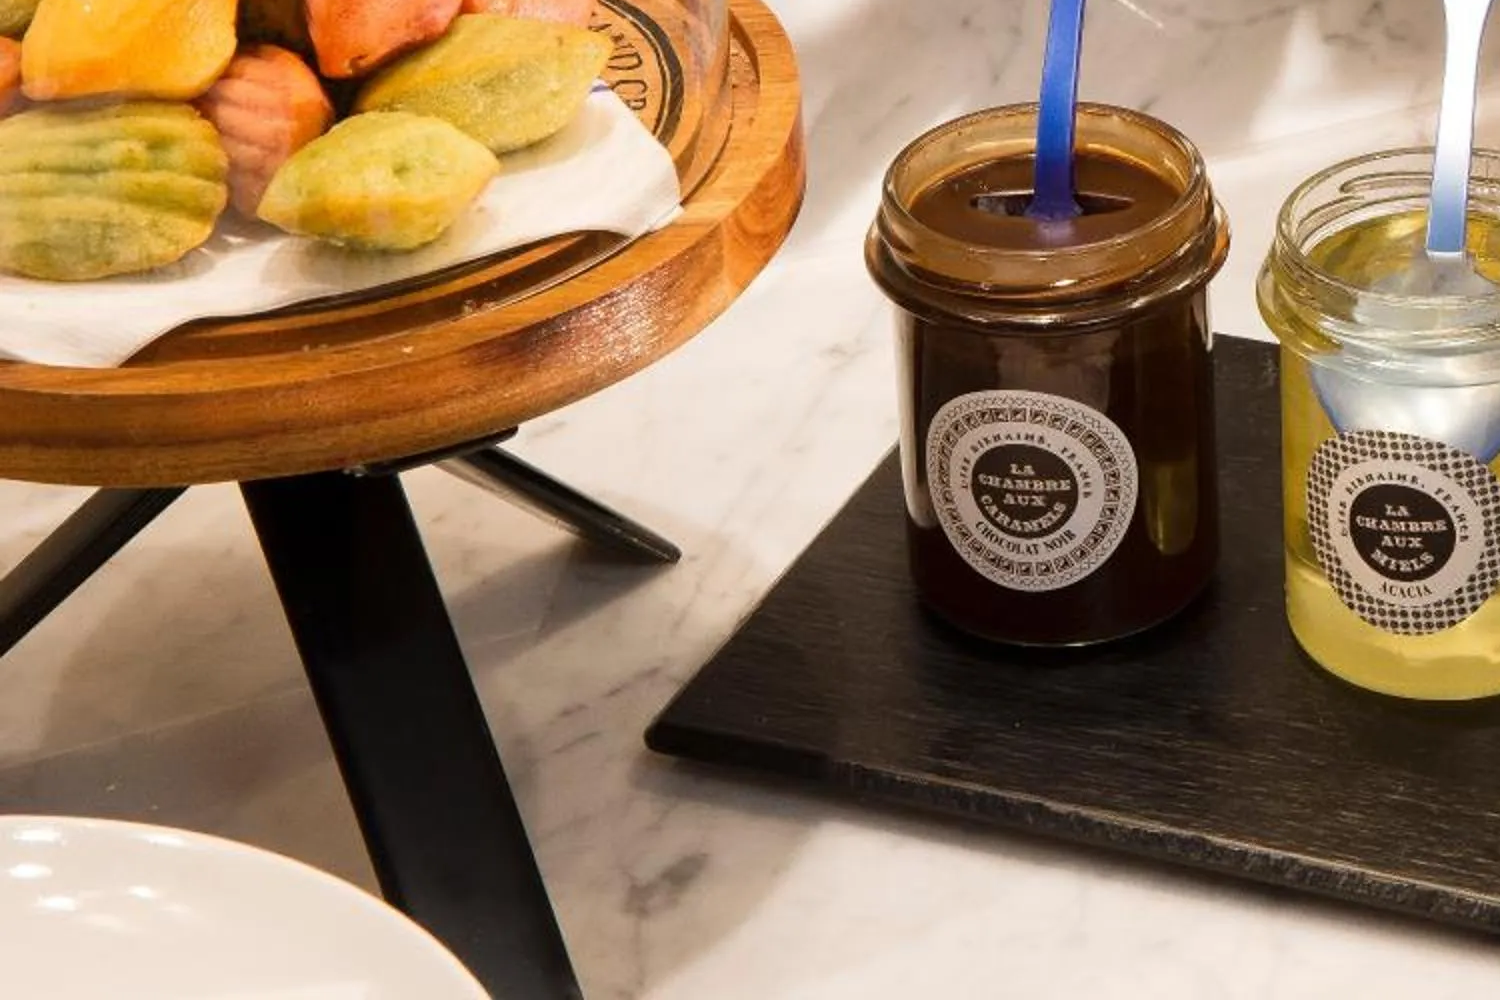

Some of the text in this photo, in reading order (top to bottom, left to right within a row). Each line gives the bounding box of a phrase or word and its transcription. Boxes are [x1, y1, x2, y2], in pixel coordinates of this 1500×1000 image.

[1009, 463, 1035, 475] LA
[977, 473, 1072, 491] CHAMBRE
[1003, 493, 1046, 507] AUX
[981, 495, 1067, 533] CARAMELS
[1384, 504, 1410, 516] LA
[1355, 515, 1449, 532] CHAMBRE
[975, 521, 1077, 554] CHOCOLAT NOIR
[1381, 535, 1424, 548] AUX
[1370, 548, 1435, 571] MIELS
[1379, 581, 1433, 599] ACACIA
